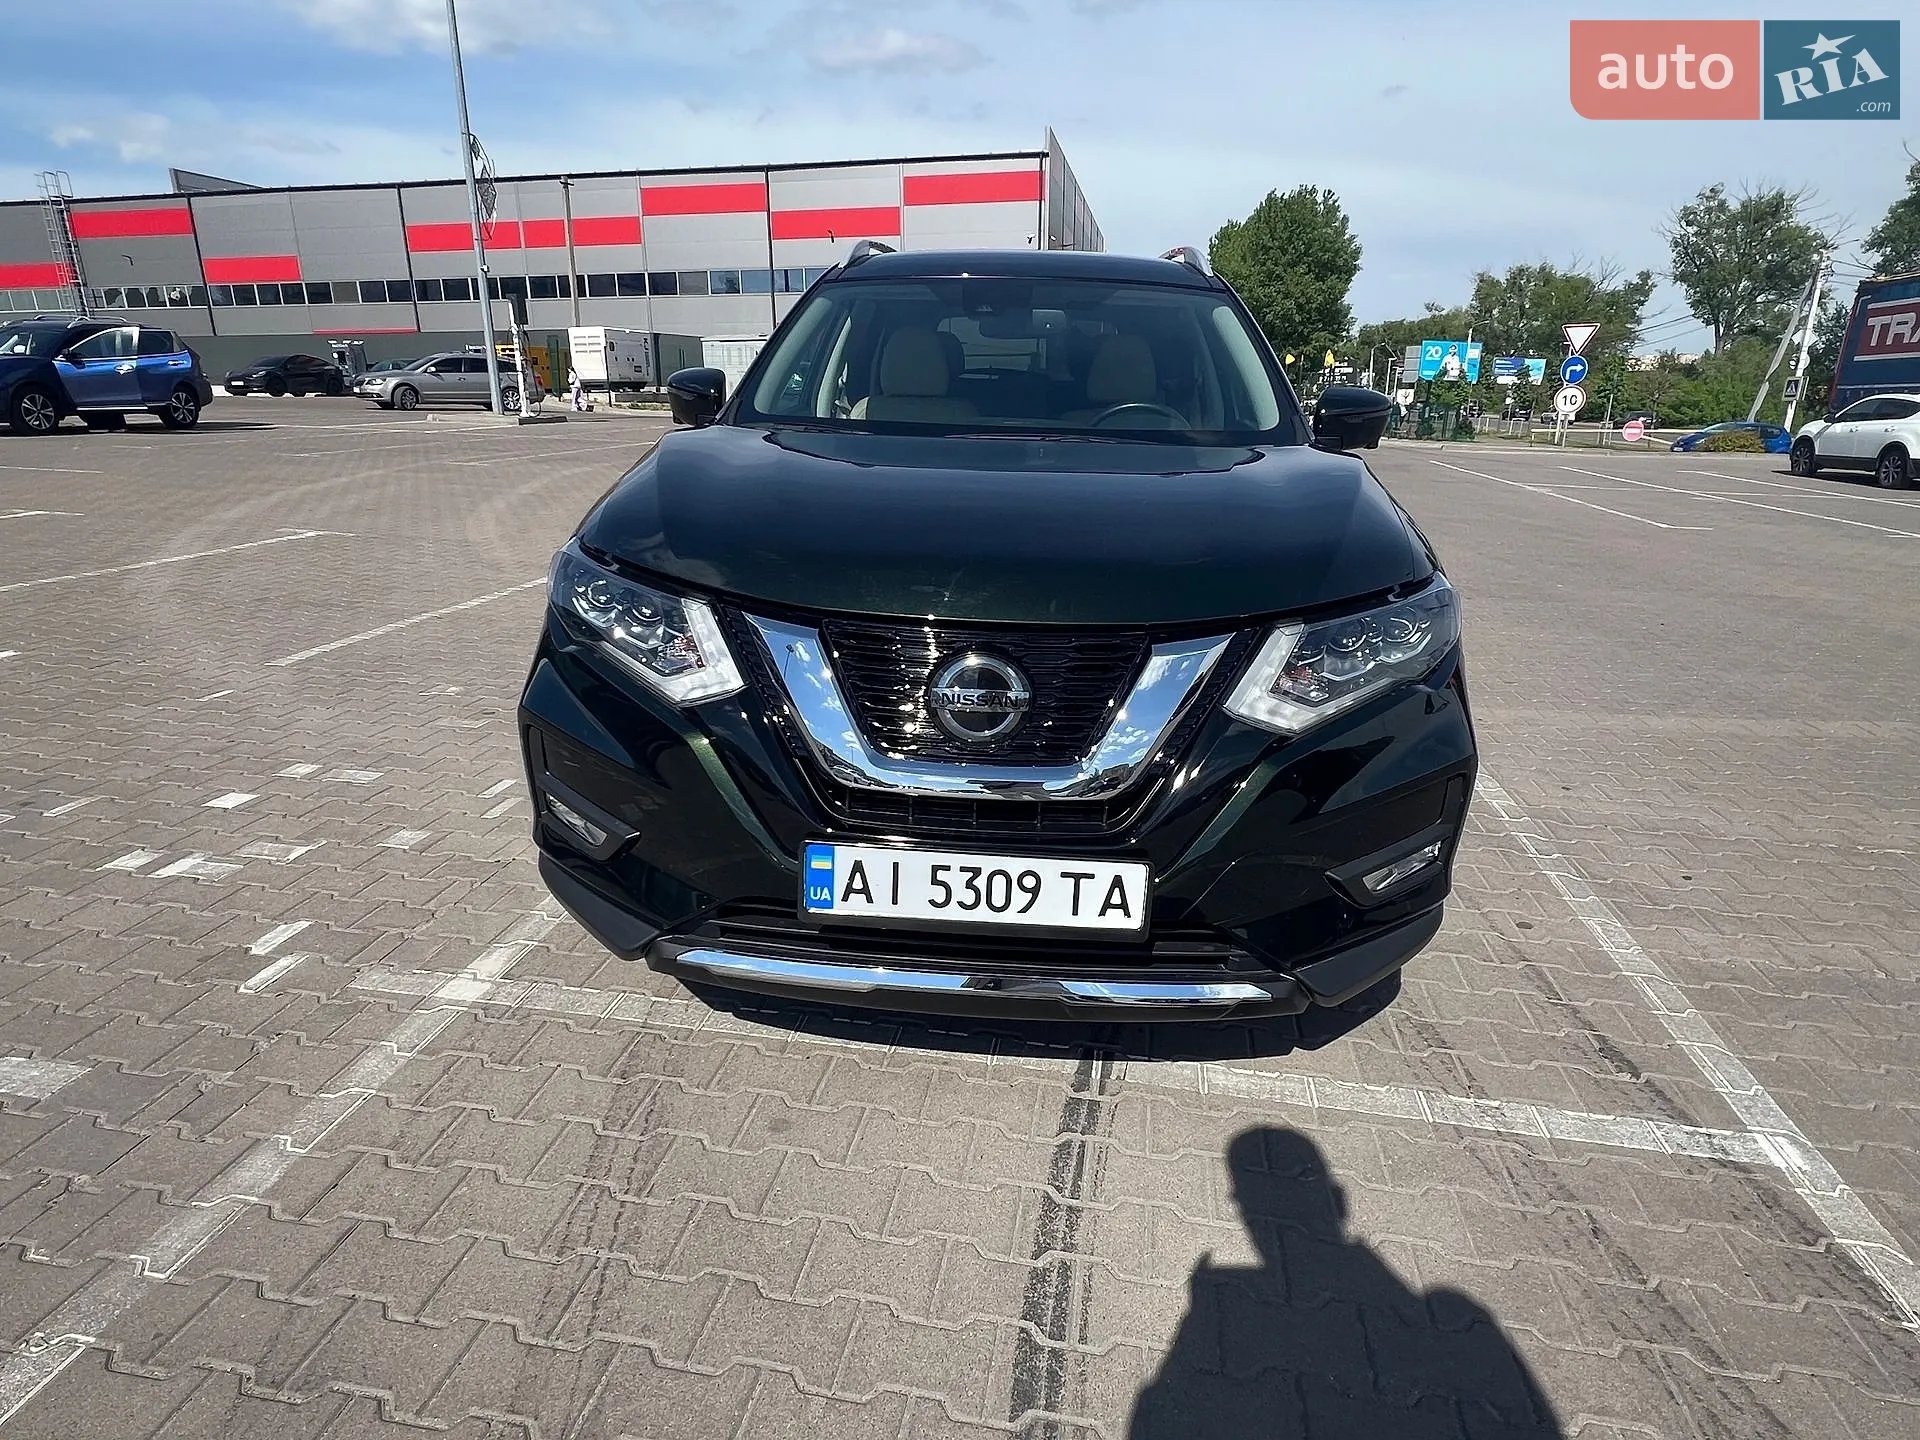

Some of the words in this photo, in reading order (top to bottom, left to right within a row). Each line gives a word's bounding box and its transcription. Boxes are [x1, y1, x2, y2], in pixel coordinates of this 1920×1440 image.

[1425, 345, 1443, 359] 20
[1562, 394, 1578, 406] 10
[940, 692, 1019, 707] NISSAN
[809, 886, 832, 901] UA
[841, 859, 900, 905] AI
[927, 864, 1042, 914] 5309
[1060, 871, 1132, 919] TA
